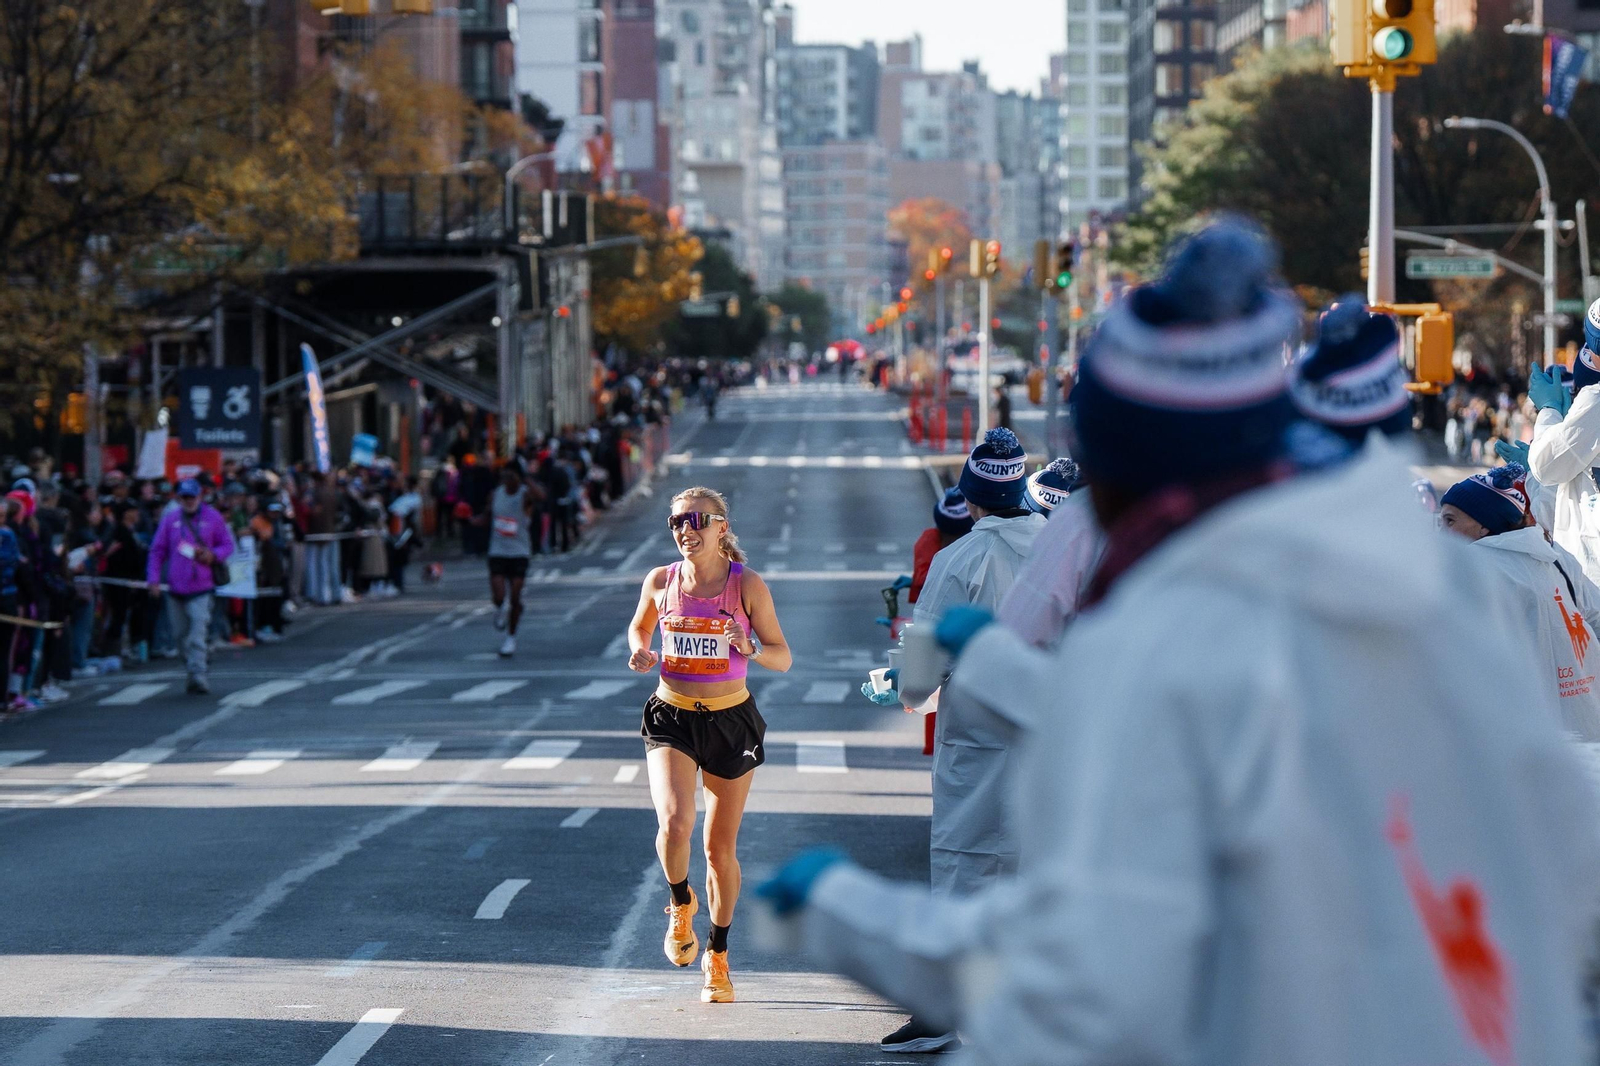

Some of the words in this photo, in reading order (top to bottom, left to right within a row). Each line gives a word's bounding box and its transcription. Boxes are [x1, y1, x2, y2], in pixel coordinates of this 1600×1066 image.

[195, 428, 246, 443] Toilets
[673, 636, 718, 656] MAYER
[1557, 666, 1574, 679] tcs
[1559, 680, 1575, 689] NEW
